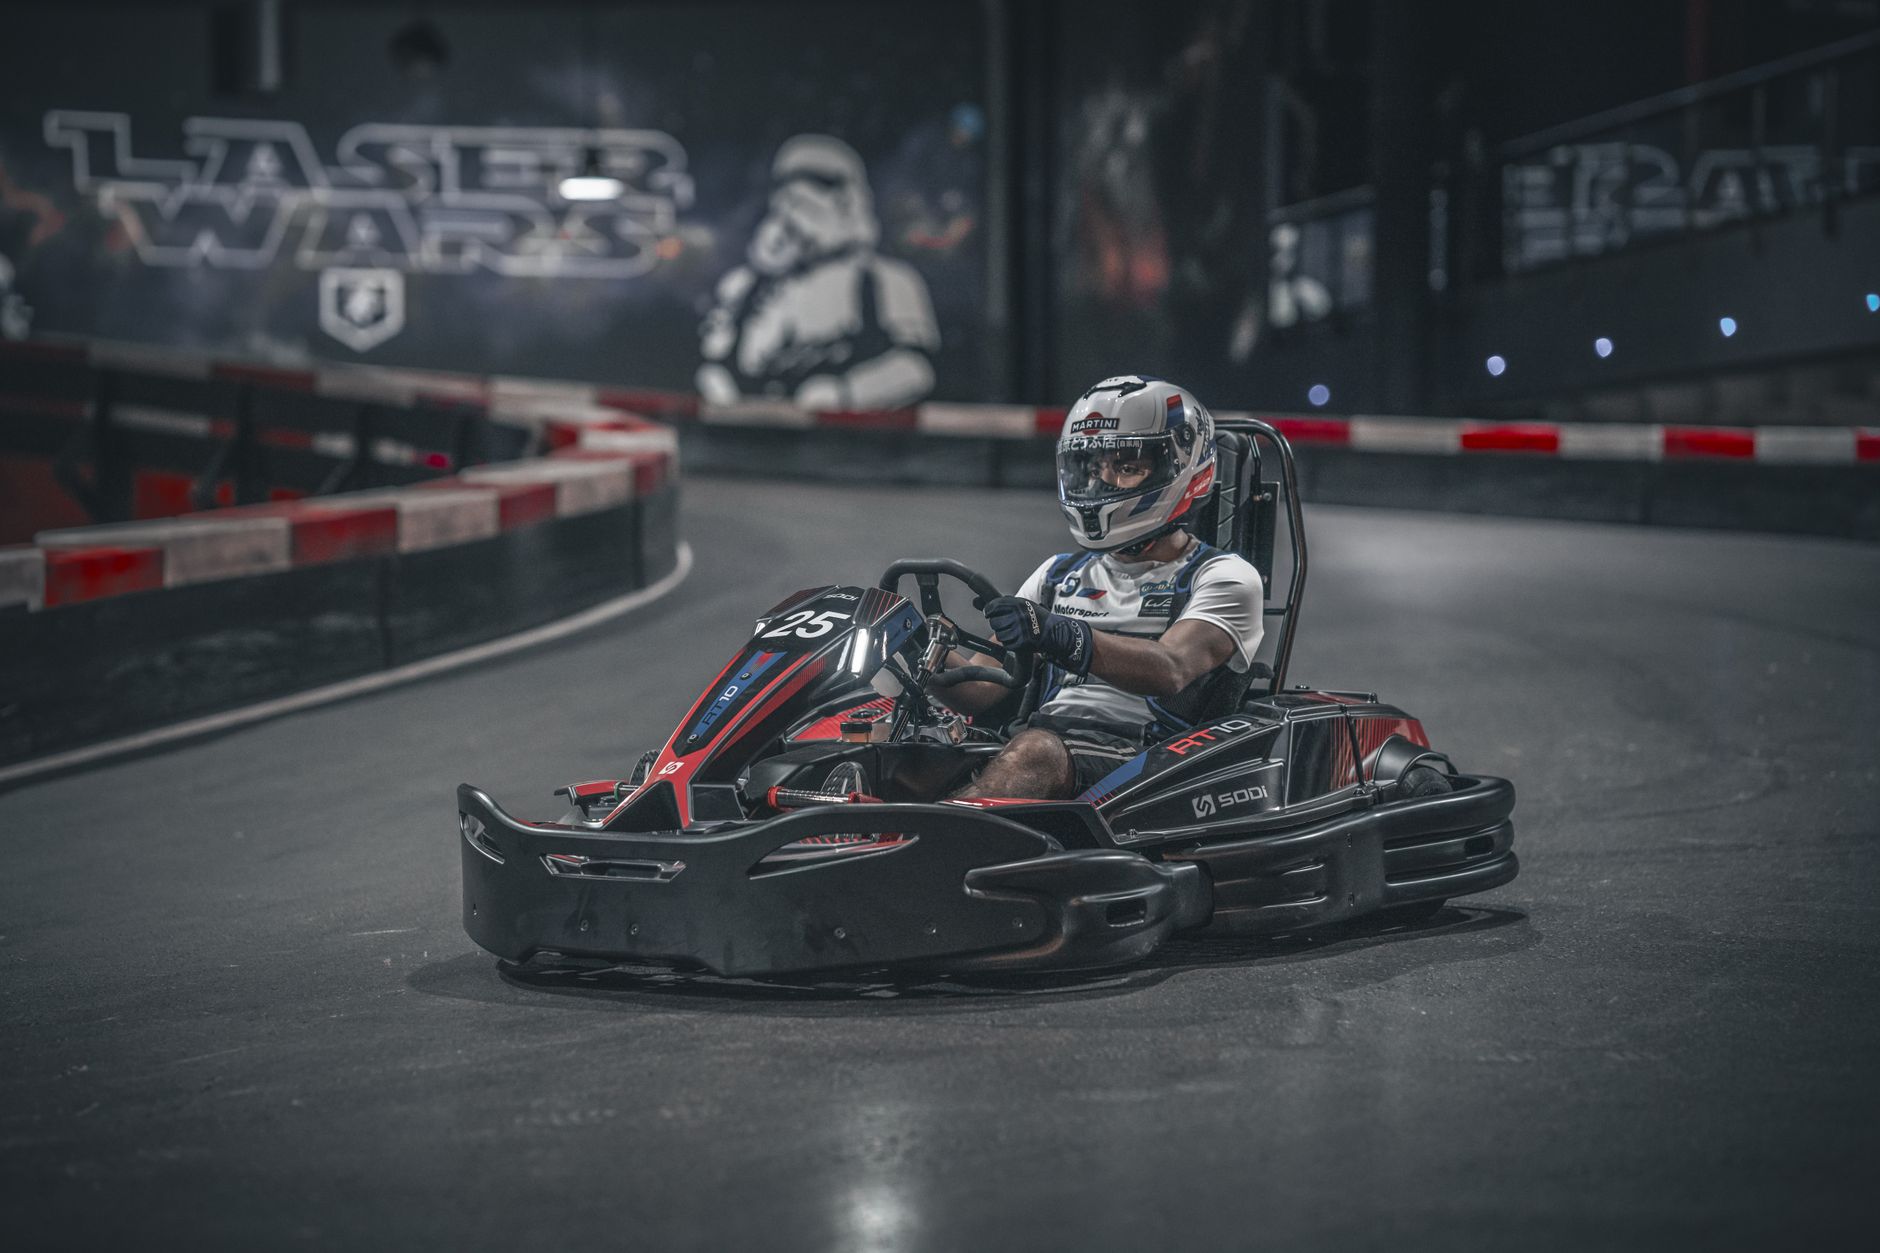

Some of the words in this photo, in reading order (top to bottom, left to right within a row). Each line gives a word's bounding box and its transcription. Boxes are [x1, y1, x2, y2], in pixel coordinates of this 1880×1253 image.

[43, 110, 695, 204] LASER
[99, 184, 678, 278] WARS
[1071, 419, 1118, 433] MARTINI
[760, 610, 852, 639] 25
[1053, 603, 1110, 618] Motorsport
[702, 685, 739, 726] RT10
[1166, 719, 1253, 755] RT10
